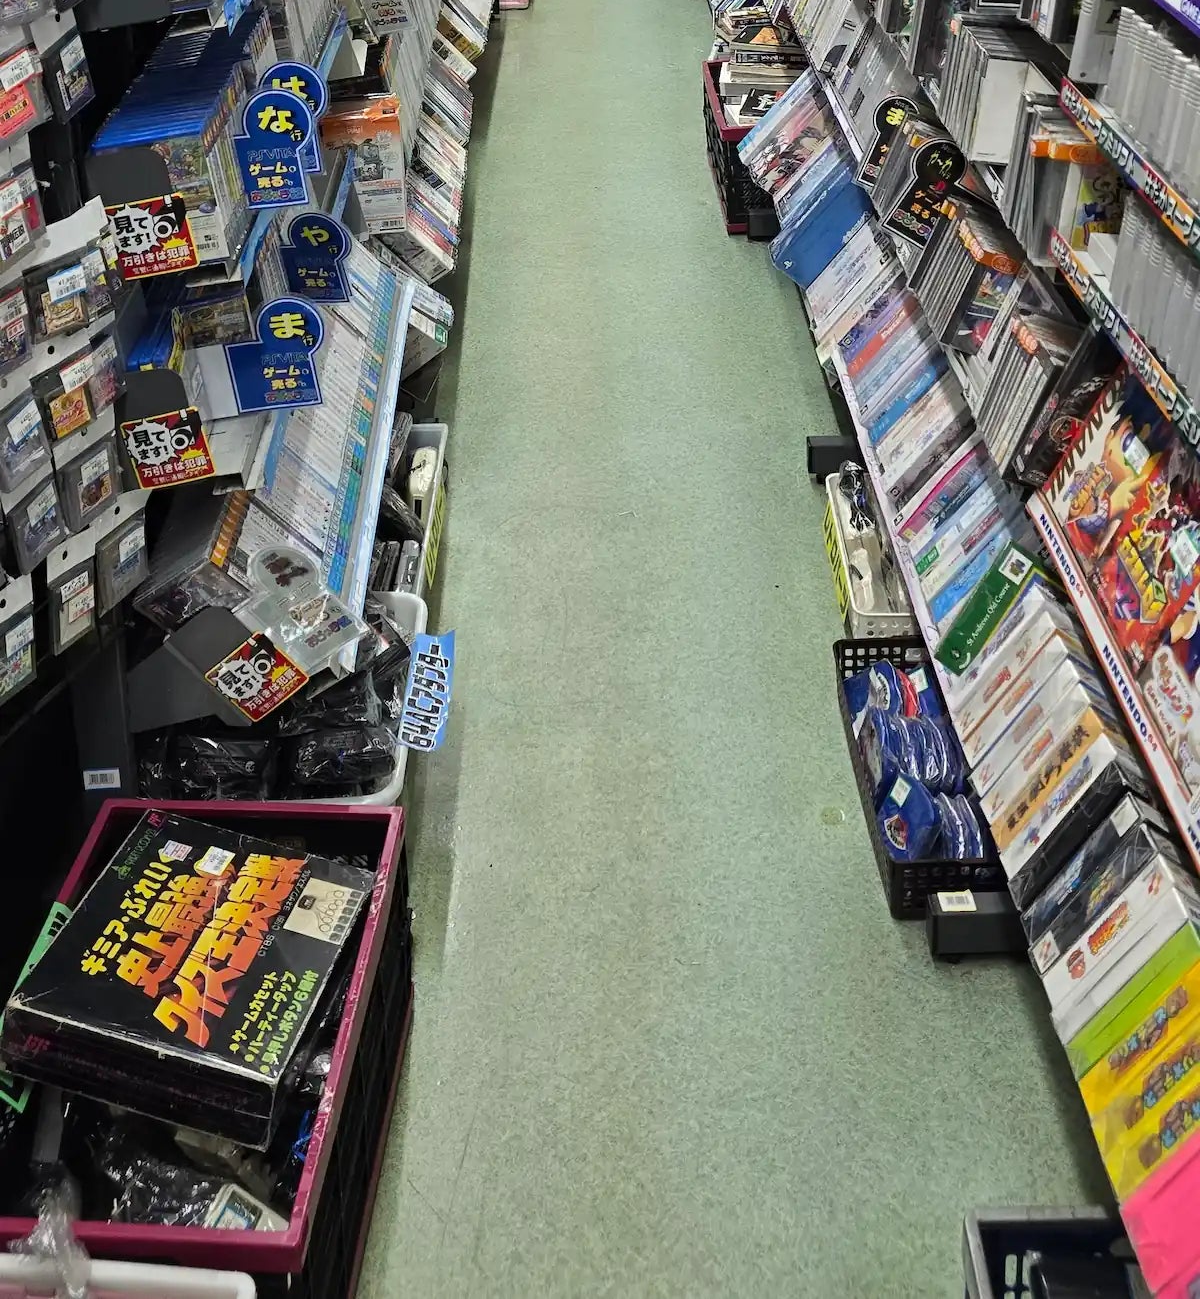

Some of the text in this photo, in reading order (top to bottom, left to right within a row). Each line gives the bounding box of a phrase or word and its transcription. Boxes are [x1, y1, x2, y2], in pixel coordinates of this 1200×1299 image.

[113, 215, 149, 235] 見て
[118, 232, 152, 248] ます!
[122, 245, 191, 267] 万引きは犯罪
[132, 429, 166, 449] 見て
[137, 445, 169, 460] ます!
[141, 455, 208, 478] 万引きは犯罪
[1039, 513, 1076, 589] NINTENDO
[966, 582, 1011, 647] St Andrews Old Course
[218, 663, 251, 689] 見て
[246, 666, 297, 711] 万引きは犯罪
[1101, 644, 1149, 744] NINTENDO
[153, 852, 310, 1049] クイズ王決定戦
